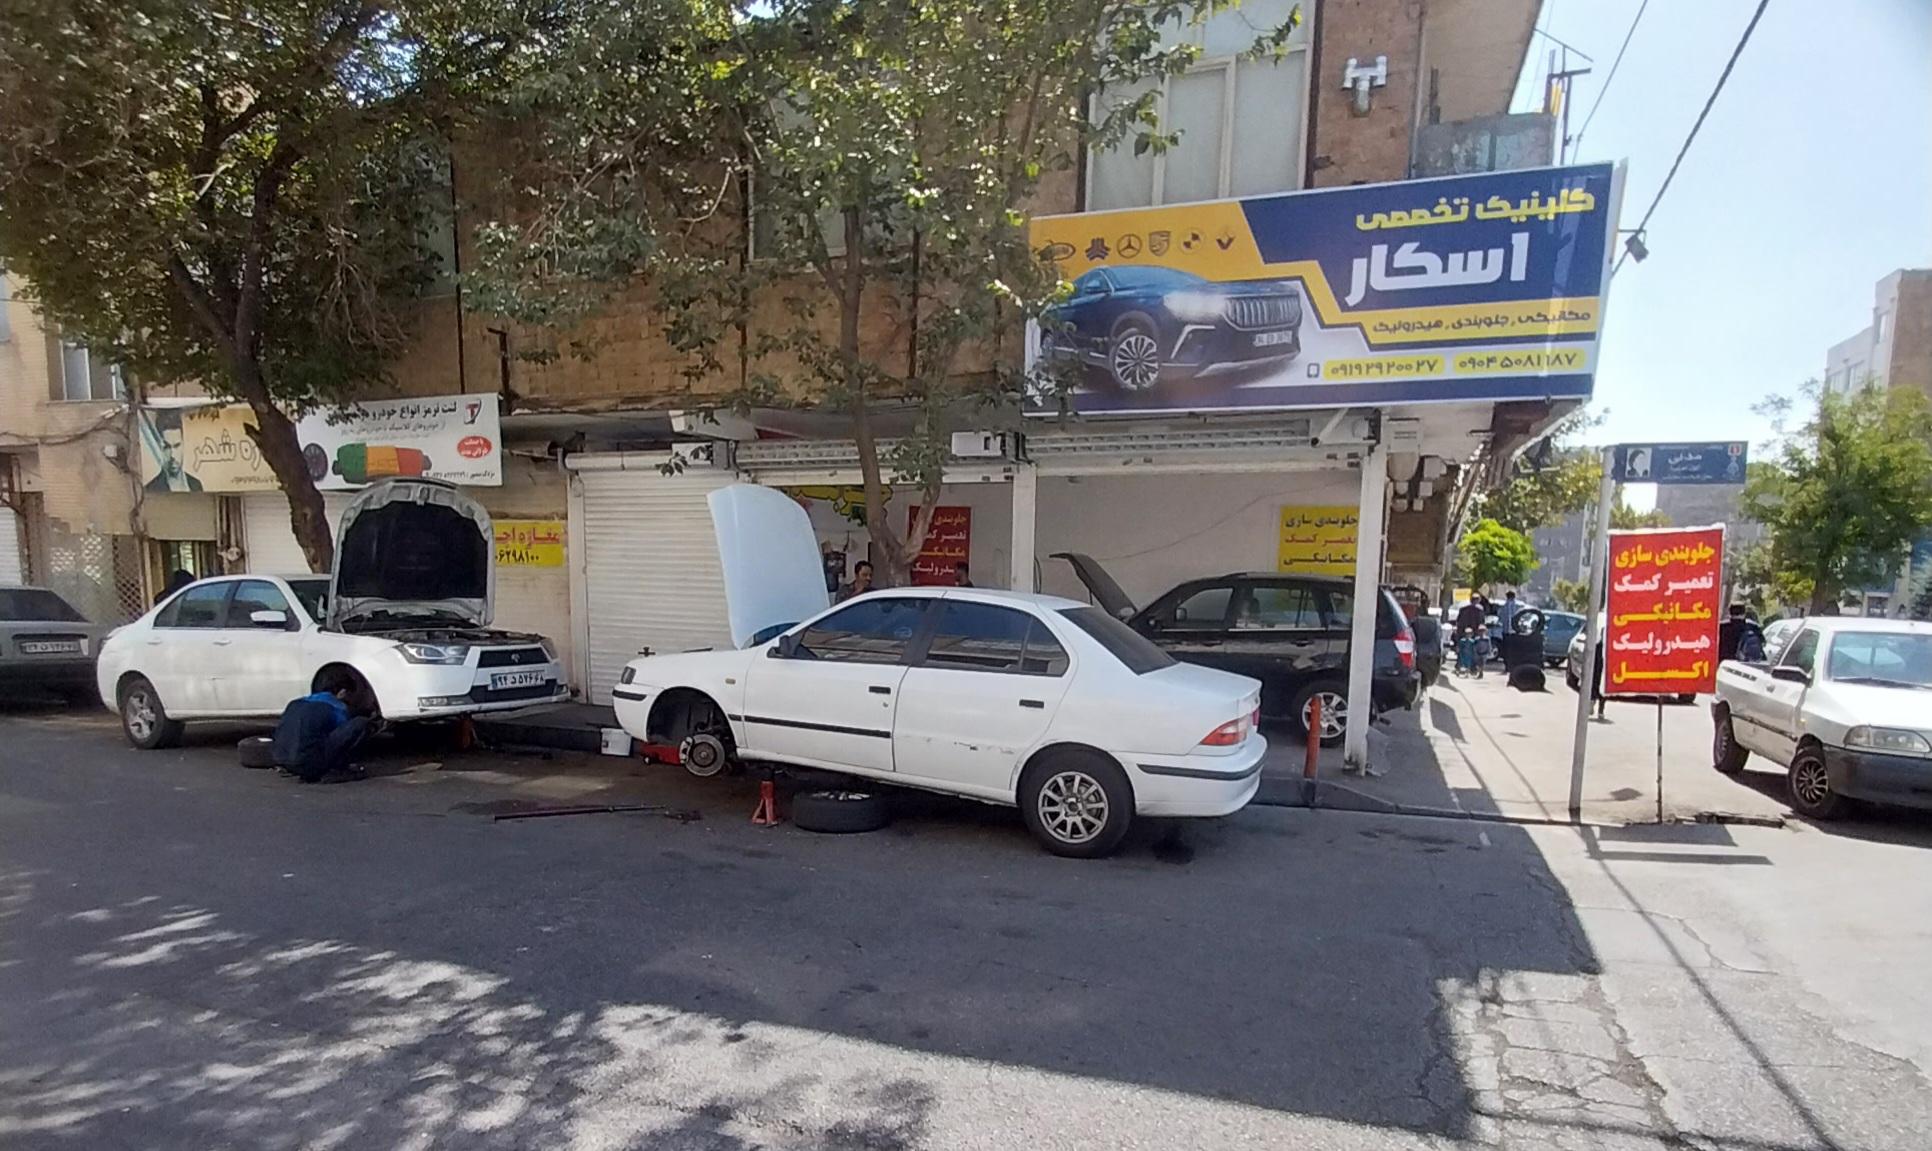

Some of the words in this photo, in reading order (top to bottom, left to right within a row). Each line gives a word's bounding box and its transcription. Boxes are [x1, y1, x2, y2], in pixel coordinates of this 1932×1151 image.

[1355, 197, 1469, 231] تخصصی
[1475, 188, 1595, 223] کلینیک
[1344, 232, 1529, 307] اسکار
[1372, 319, 1444, 334] هیدرولیک
[193, 428, 237, 472] شهر
[1285, 514, 1312, 528] سازی
[1314, 514, 1358, 528] جلوبندی
[1615, 545, 1652, 568] سازی
[1655, 542, 1715, 567] جلوبندی
[1614, 573, 1662, 592] کمک
[1664, 572, 1714, 596] تعمیر
[1613, 602, 1712, 627] مکانیکی
[1612, 632, 1711, 656] هیدرولیک
[1612, 660, 1709, 684] اکسل
